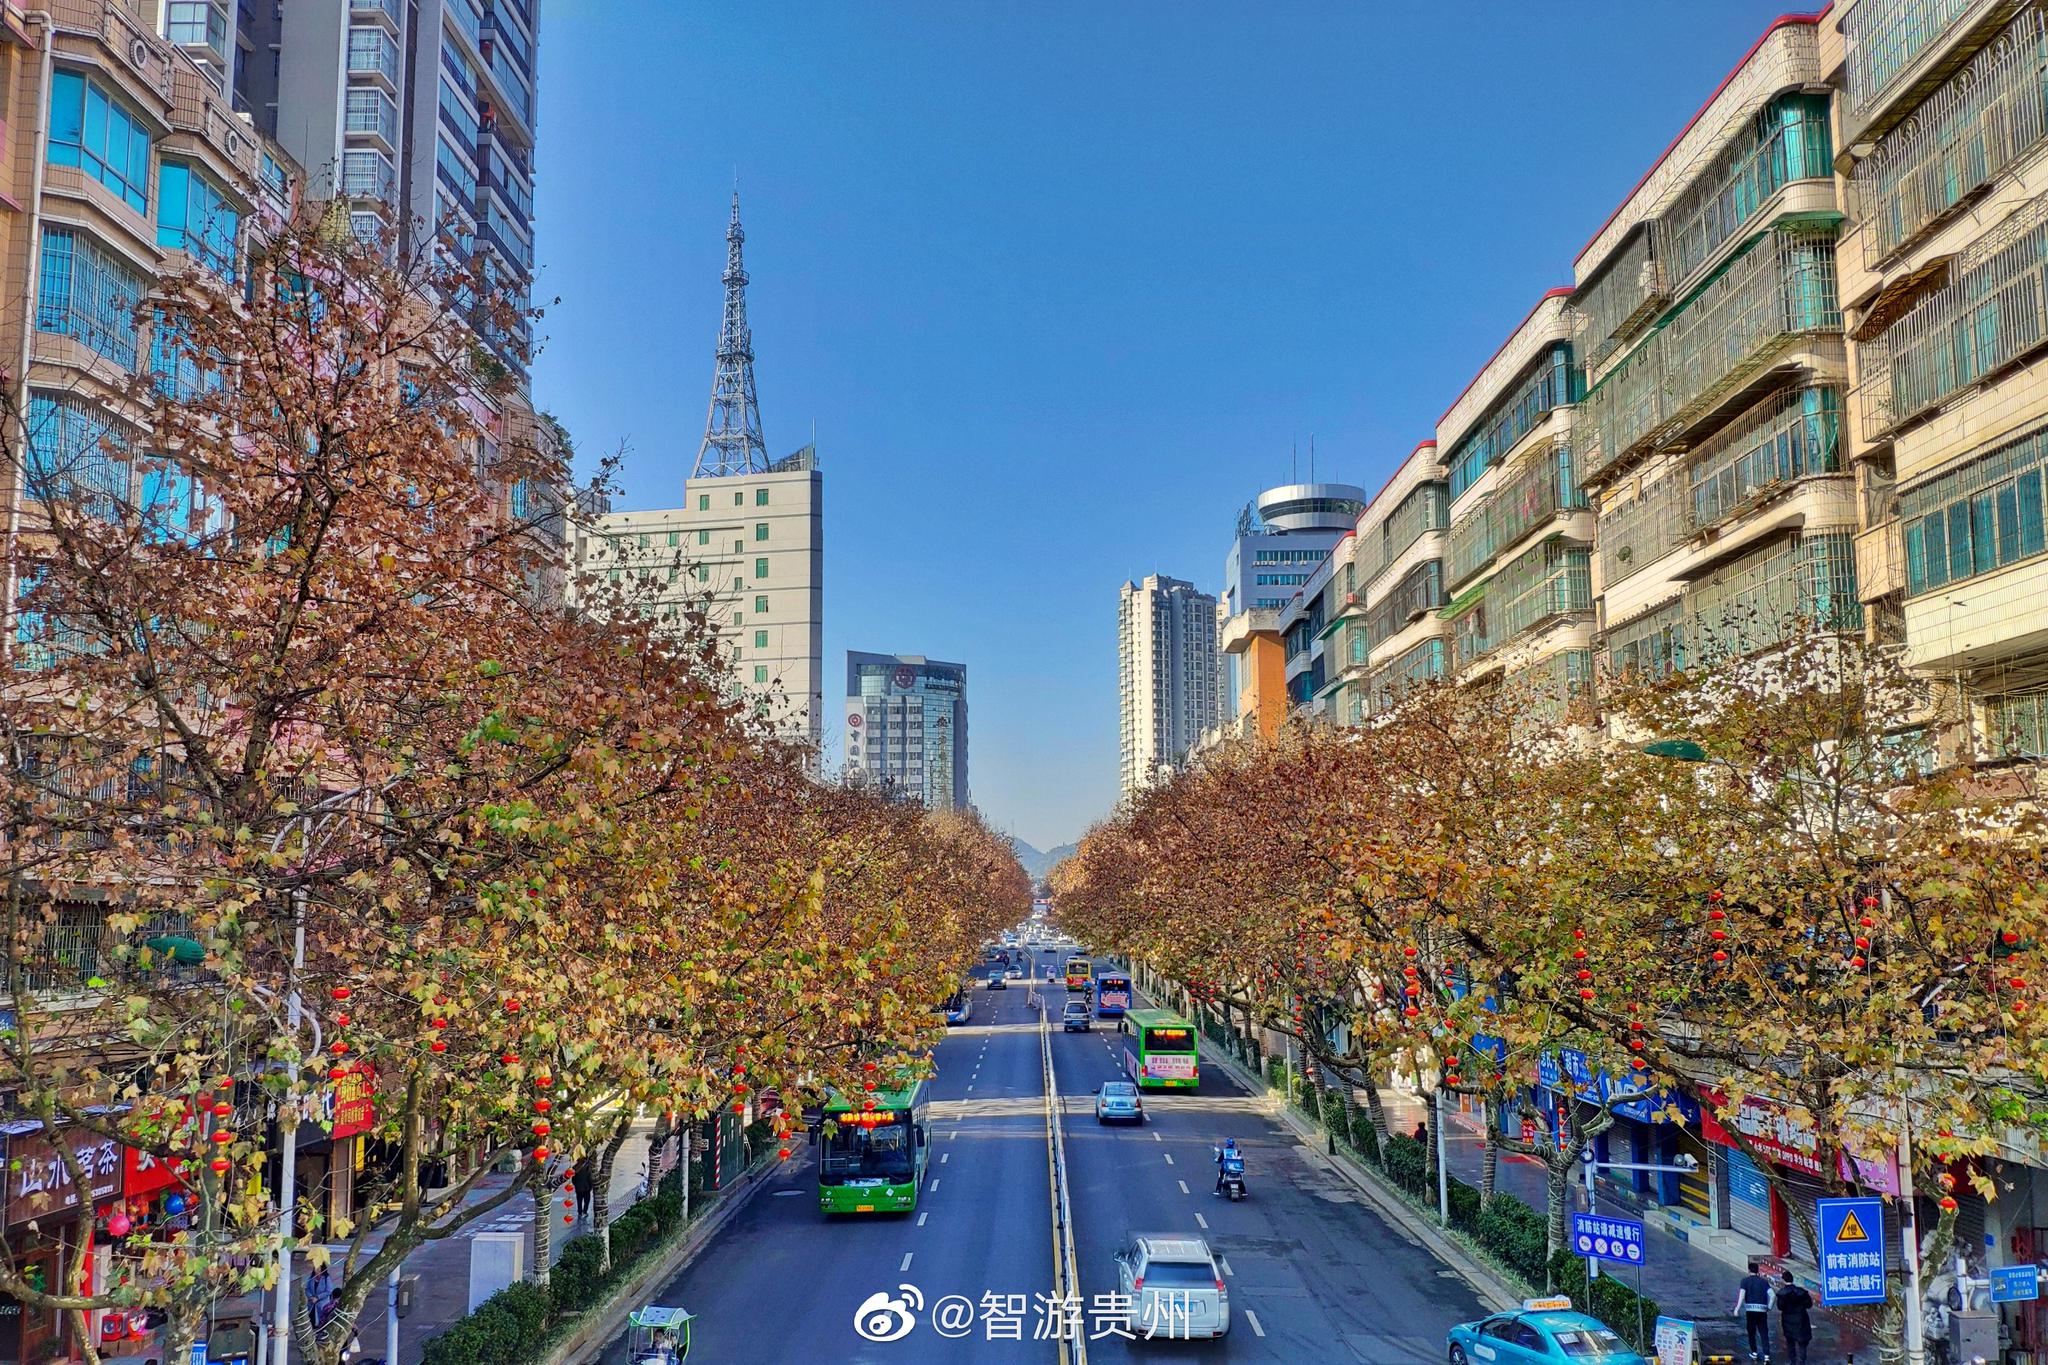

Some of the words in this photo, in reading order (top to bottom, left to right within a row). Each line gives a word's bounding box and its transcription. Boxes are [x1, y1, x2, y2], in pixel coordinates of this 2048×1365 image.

[20, 1141, 117, 1198] 山水茗茶
[1577, 1218, 1640, 1242] 消防站请减速慢行
[1613, 1245, 1622, 1253] 15
[1826, 1252, 1881, 1269] 前有消防站
[1828, 1274, 1881, 1292] 请减速慢行
